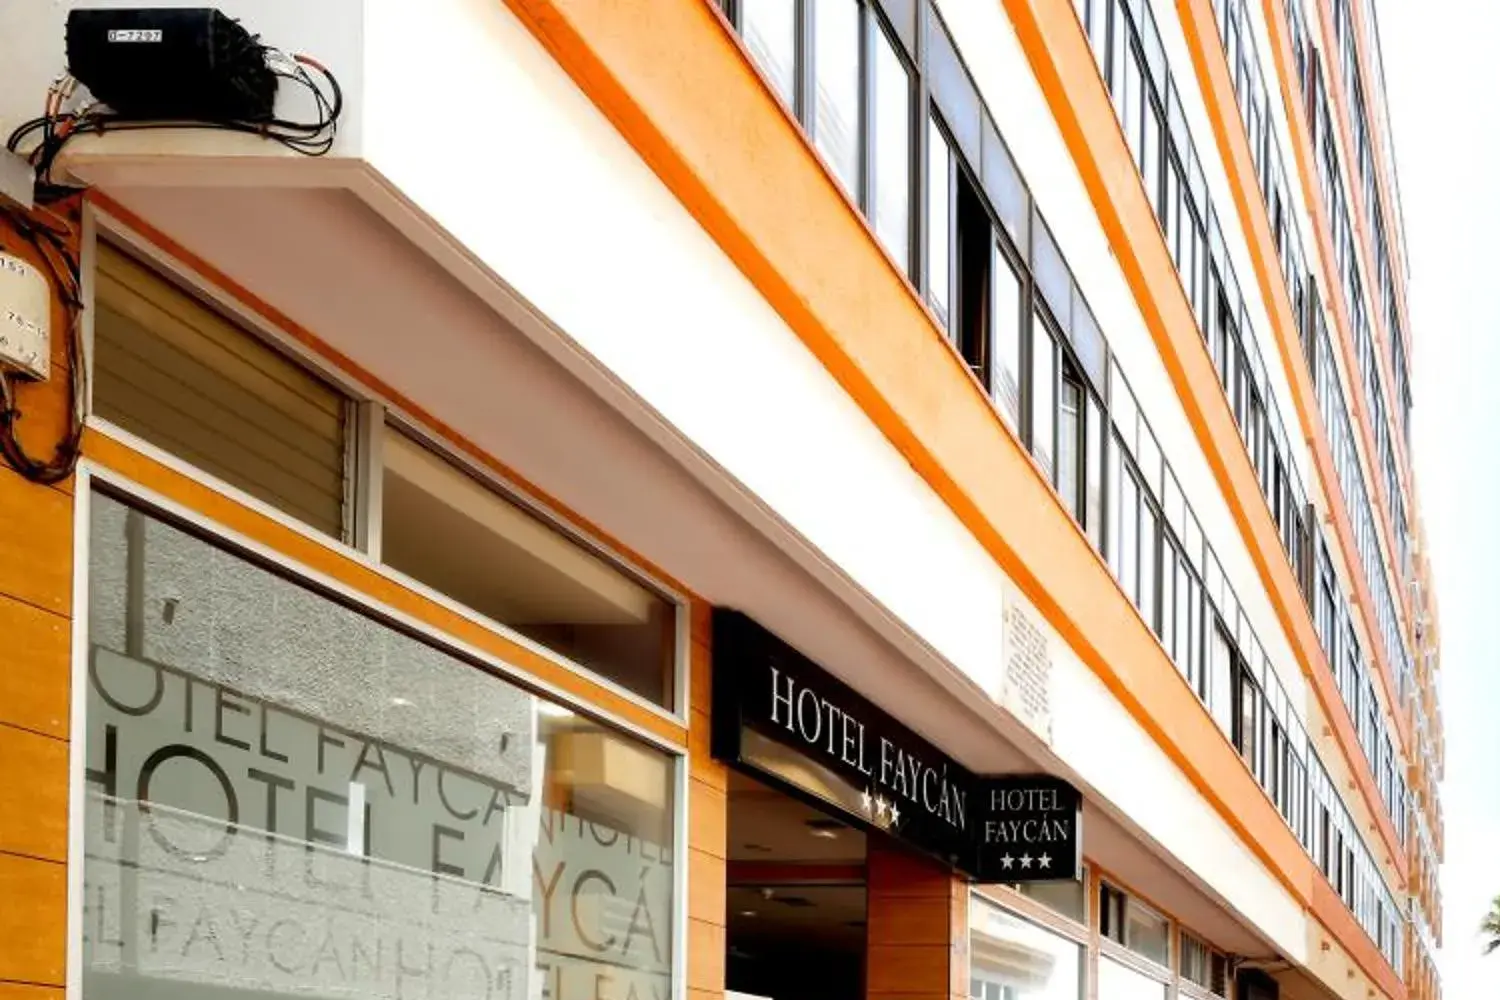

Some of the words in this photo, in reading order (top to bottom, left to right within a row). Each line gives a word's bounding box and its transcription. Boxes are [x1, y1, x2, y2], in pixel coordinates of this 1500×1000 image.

[770, 666, 873, 775] HOTEL
[880, 737, 967, 831] FAYCÁN
[990, 788, 1065, 812] HOTEL
[984, 814, 1069, 843] FAYCÁN
